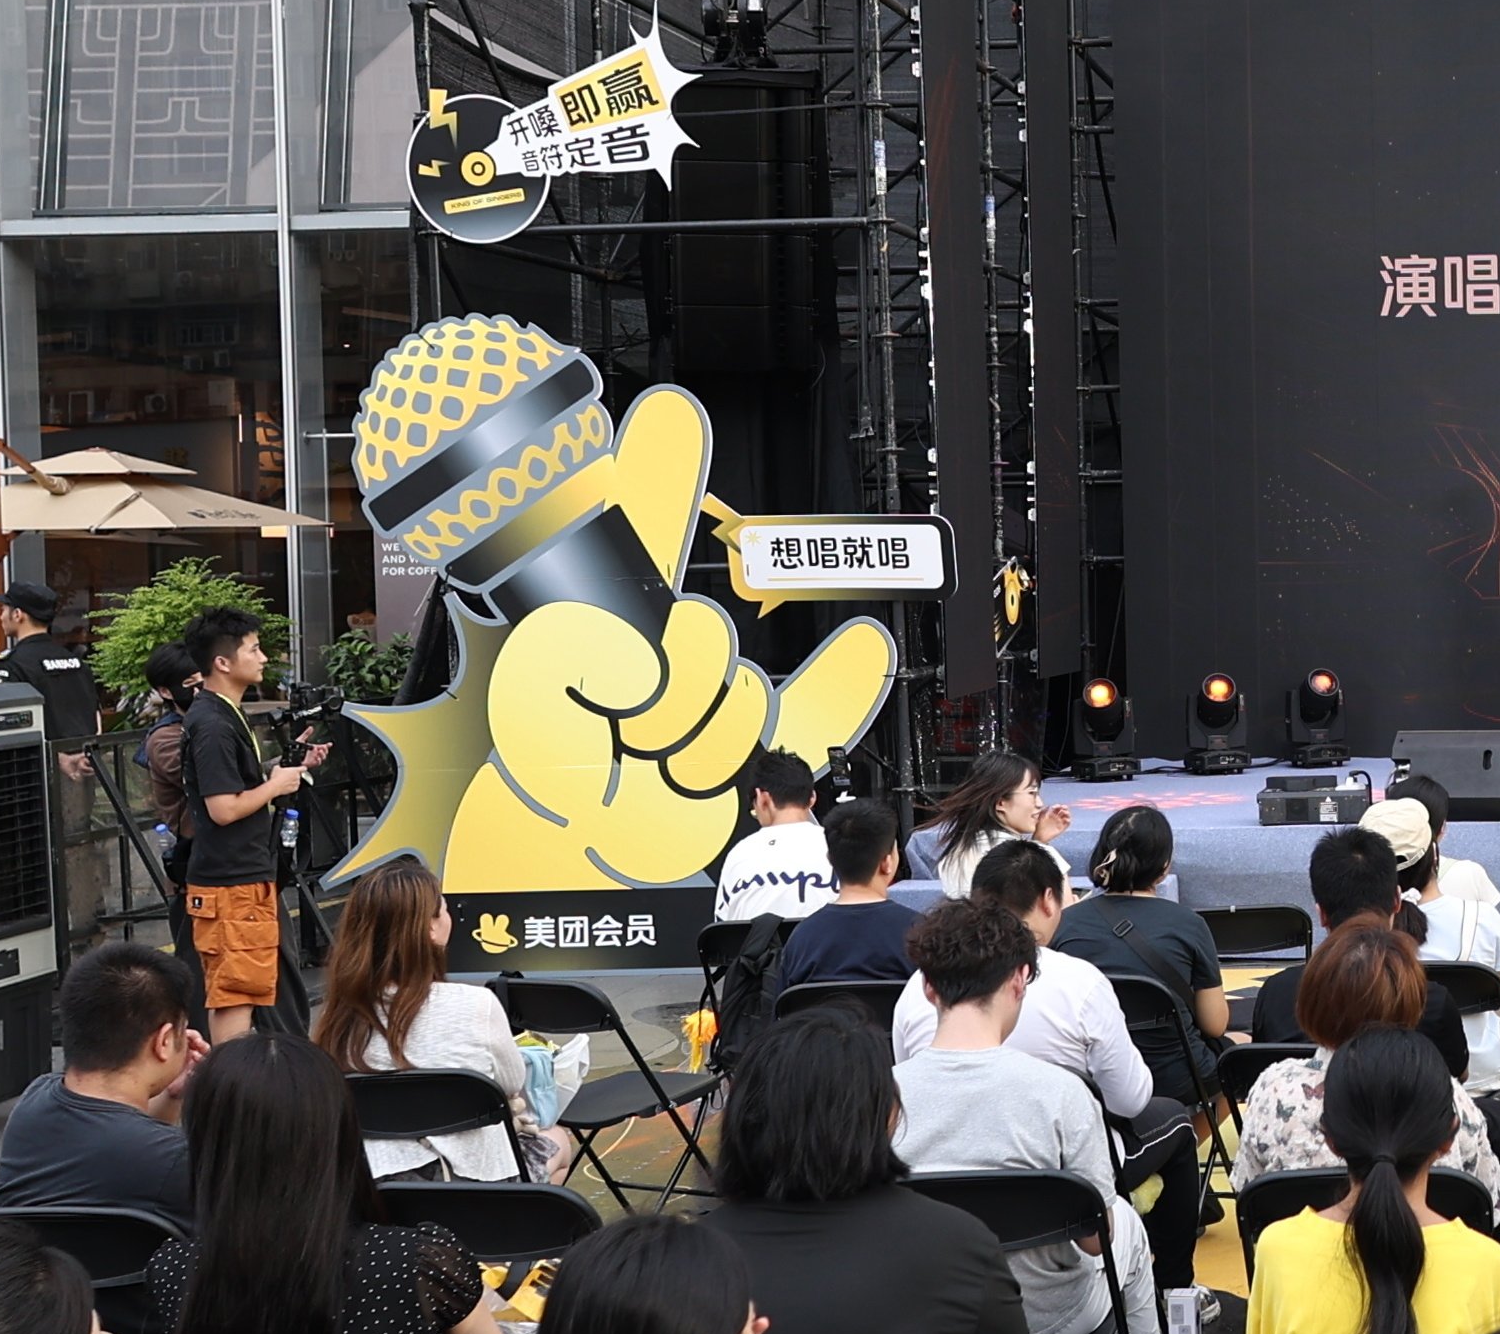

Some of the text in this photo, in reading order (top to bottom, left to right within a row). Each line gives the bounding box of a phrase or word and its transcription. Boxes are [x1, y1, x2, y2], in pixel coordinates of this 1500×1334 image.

[521, 123, 650, 173] 音符定音
[381, 542, 400, 552] WE
[769, 535, 911, 570] 想唱就唱
[382, 554, 406, 564] AND
[382, 566, 405, 576] FOR
[523, 914, 657, 949] 美团会员
